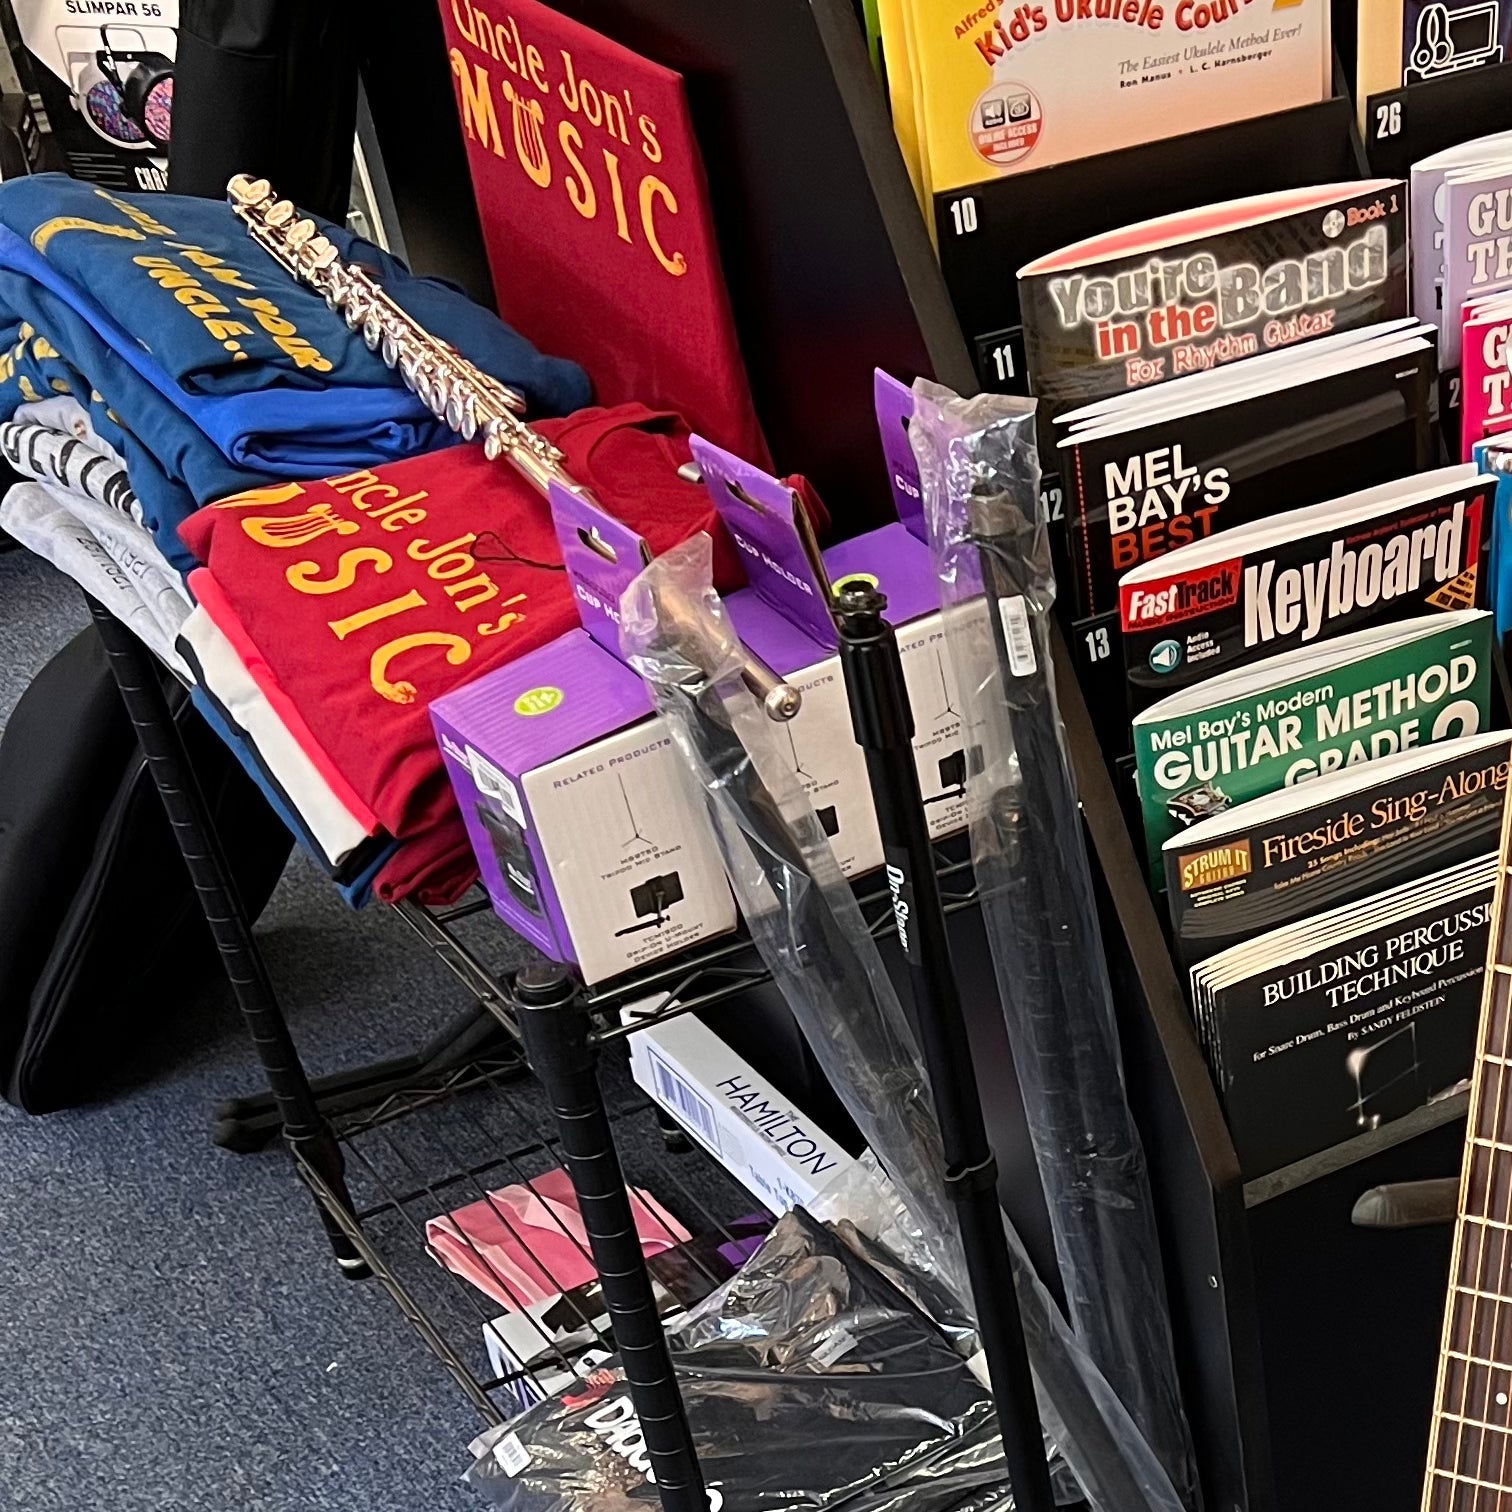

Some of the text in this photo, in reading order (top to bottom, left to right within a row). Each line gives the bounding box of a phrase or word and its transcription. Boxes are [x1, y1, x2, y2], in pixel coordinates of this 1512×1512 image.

[66, 0, 162, 17] SLIMPAR 56
[975, 4, 1047, 66] Kid's
[452, 0, 662, 163] Uncle Jon's
[1117, 60, 1140, 76] The
[1141, 50, 1181, 72] Easiest
[1183, 40, 1226, 62] Ukulele
[1228, 30, 1270, 52] Method
[1119, 49, 1273, 89] Ron Manus Harnsberger
[1377, 100, 1402, 140] 26
[450, 48, 687, 277] MUSIC
[950, 197, 977, 236] 10
[1346, 195, 1399, 227] Book 1
[1098, 225, 1390, 359] in the Band
[992, 344, 1017, 382] 11
[1126, 309, 1335, 387] For Rhythm Guitar
[1103, 444, 1198, 500] MEL
[1107, 467, 1231, 535] BAY'S
[1040, 487, 1065, 523] 12
[326, 469, 528, 636] ncle Jon's
[1111, 505, 1220, 571] BEST
[1127, 566, 1236, 623] FastTrack
[1243, 499, 1466, 649] Keyboard
[1462, 493, 1486, 563] 1
[1085, 628, 1110, 664] 13
[1150, 684, 1334, 752] Mel Bay's Modern
[1152, 654, 1477, 790] GUITAR METHOD
[553, 738, 671, 790] RELATED PRODUCTS
[1262, 819, 1365, 870] Fireside
[1369, 760, 1511, 831] Sing-Along
[1183, 846, 1232, 889] STRUM
[1234, 849, 1249, 874] IT
[1263, 946, 1379, 1007] BUILDING
[1326, 939, 1465, 1008] TECHNIQUE
[1252, 1050, 1267, 1062] for
[1268, 1039, 1295, 1056] Snare
[1327, 1018, 1348, 1034] Bass
[1349, 1008, 1376, 1025] Drum
[1377, 1000, 1394, 1017] and
[1394, 982, 1437, 1009] Keyboard
[1437, 965, 1484, 992] Percussion
[1347, 995, 1446, 1042] By SANDY FELDSTEIN
[715, 1075, 838, 1175] HAMILTON
